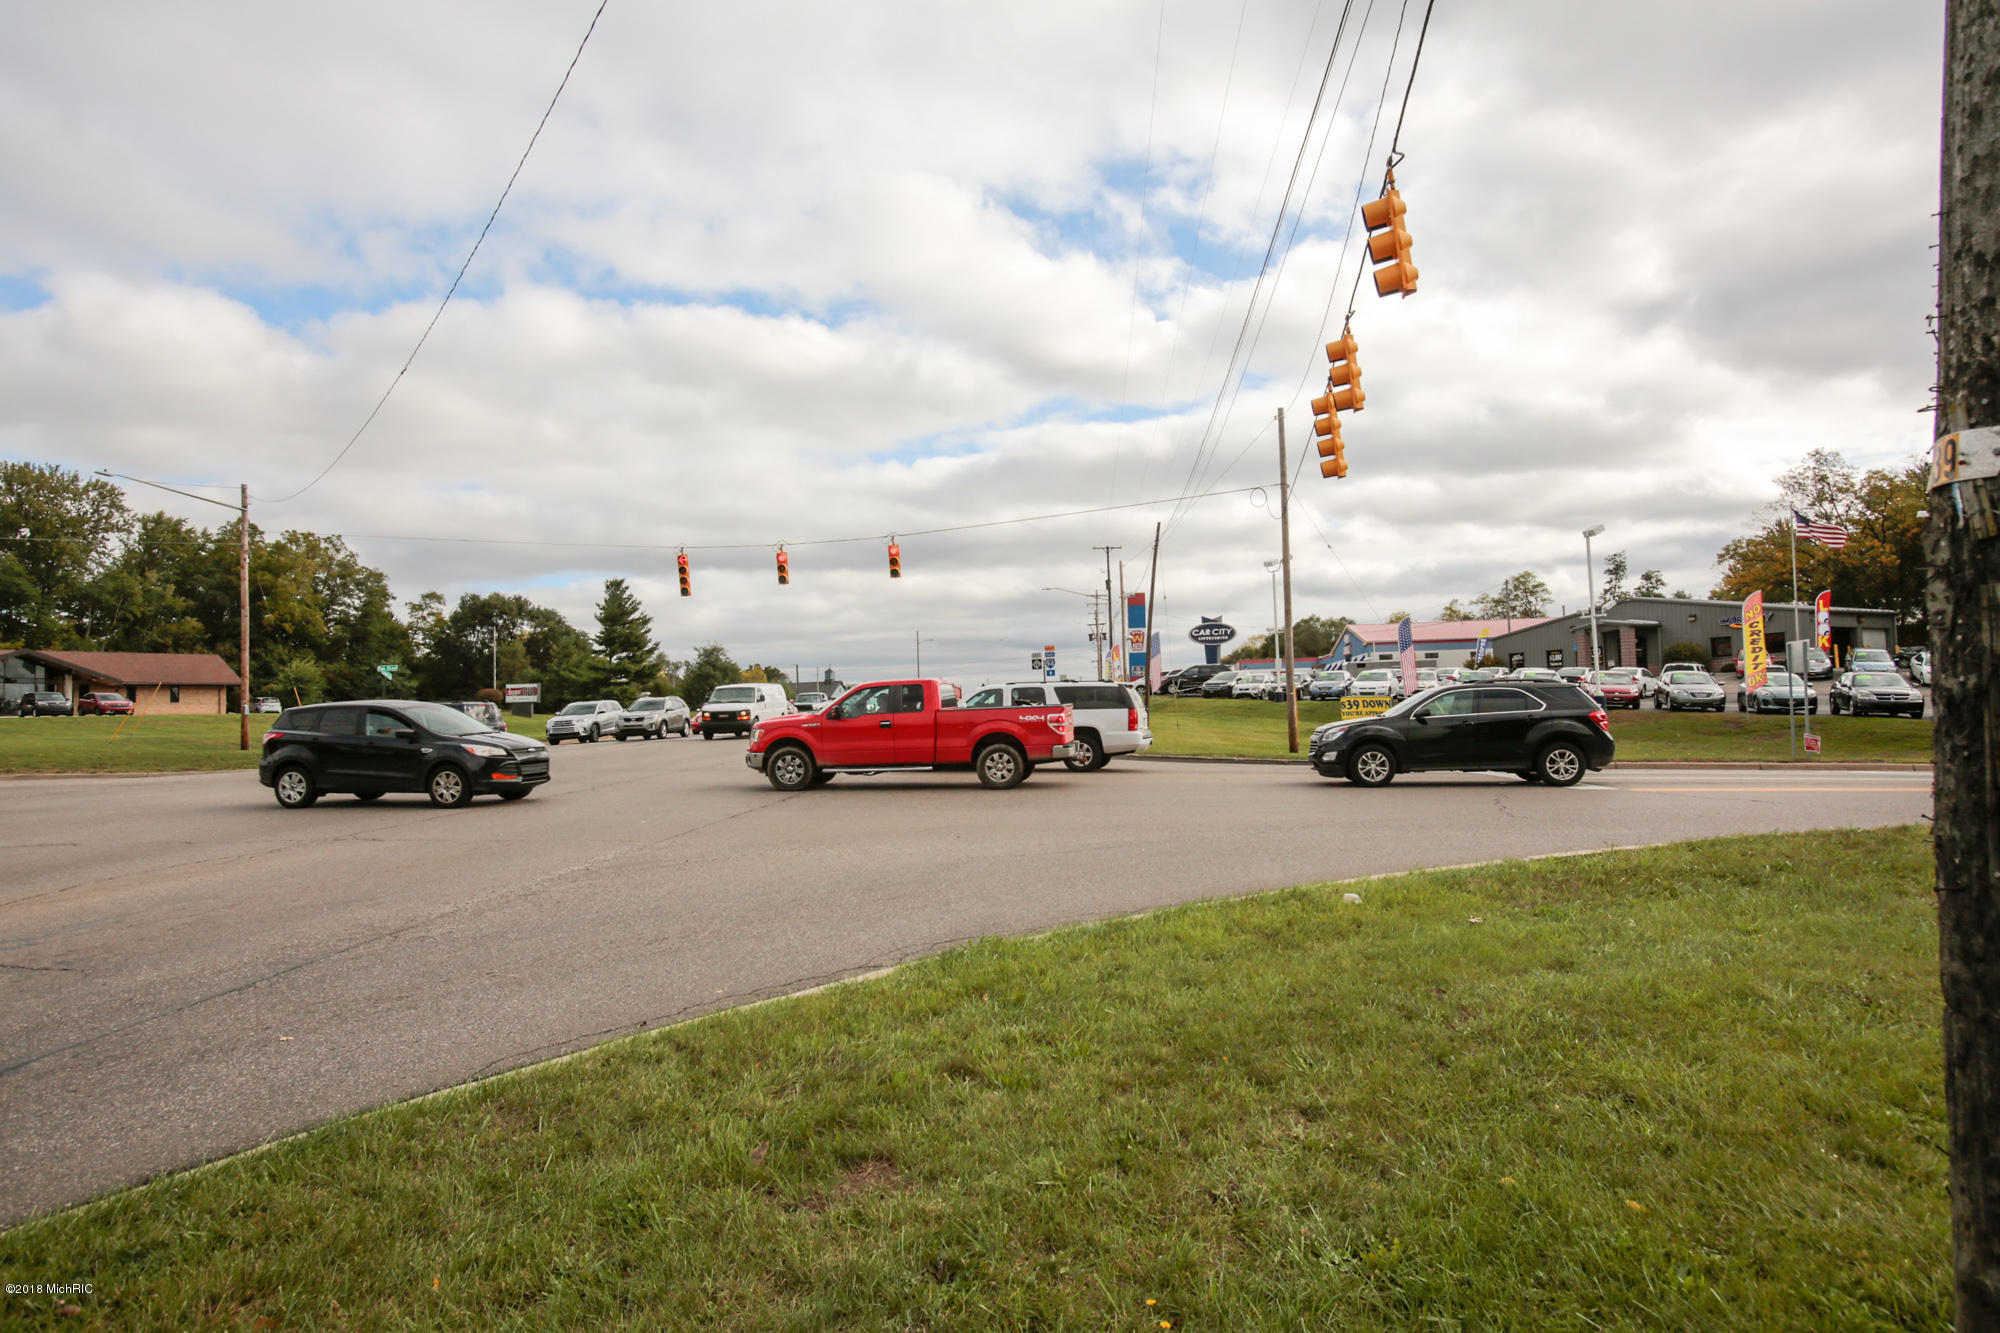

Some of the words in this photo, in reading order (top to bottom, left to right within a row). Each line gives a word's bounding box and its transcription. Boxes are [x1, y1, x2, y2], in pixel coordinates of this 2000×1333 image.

[1745, 604, 1761, 621] NO
[1192, 629, 1211, 637] CAR
[1212, 627, 1233, 636] CITY
[1749, 621, 1764, 670] CREDIT
[1341, 699, 1360, 710] $39
[1362, 699, 1391, 709] DOWN
